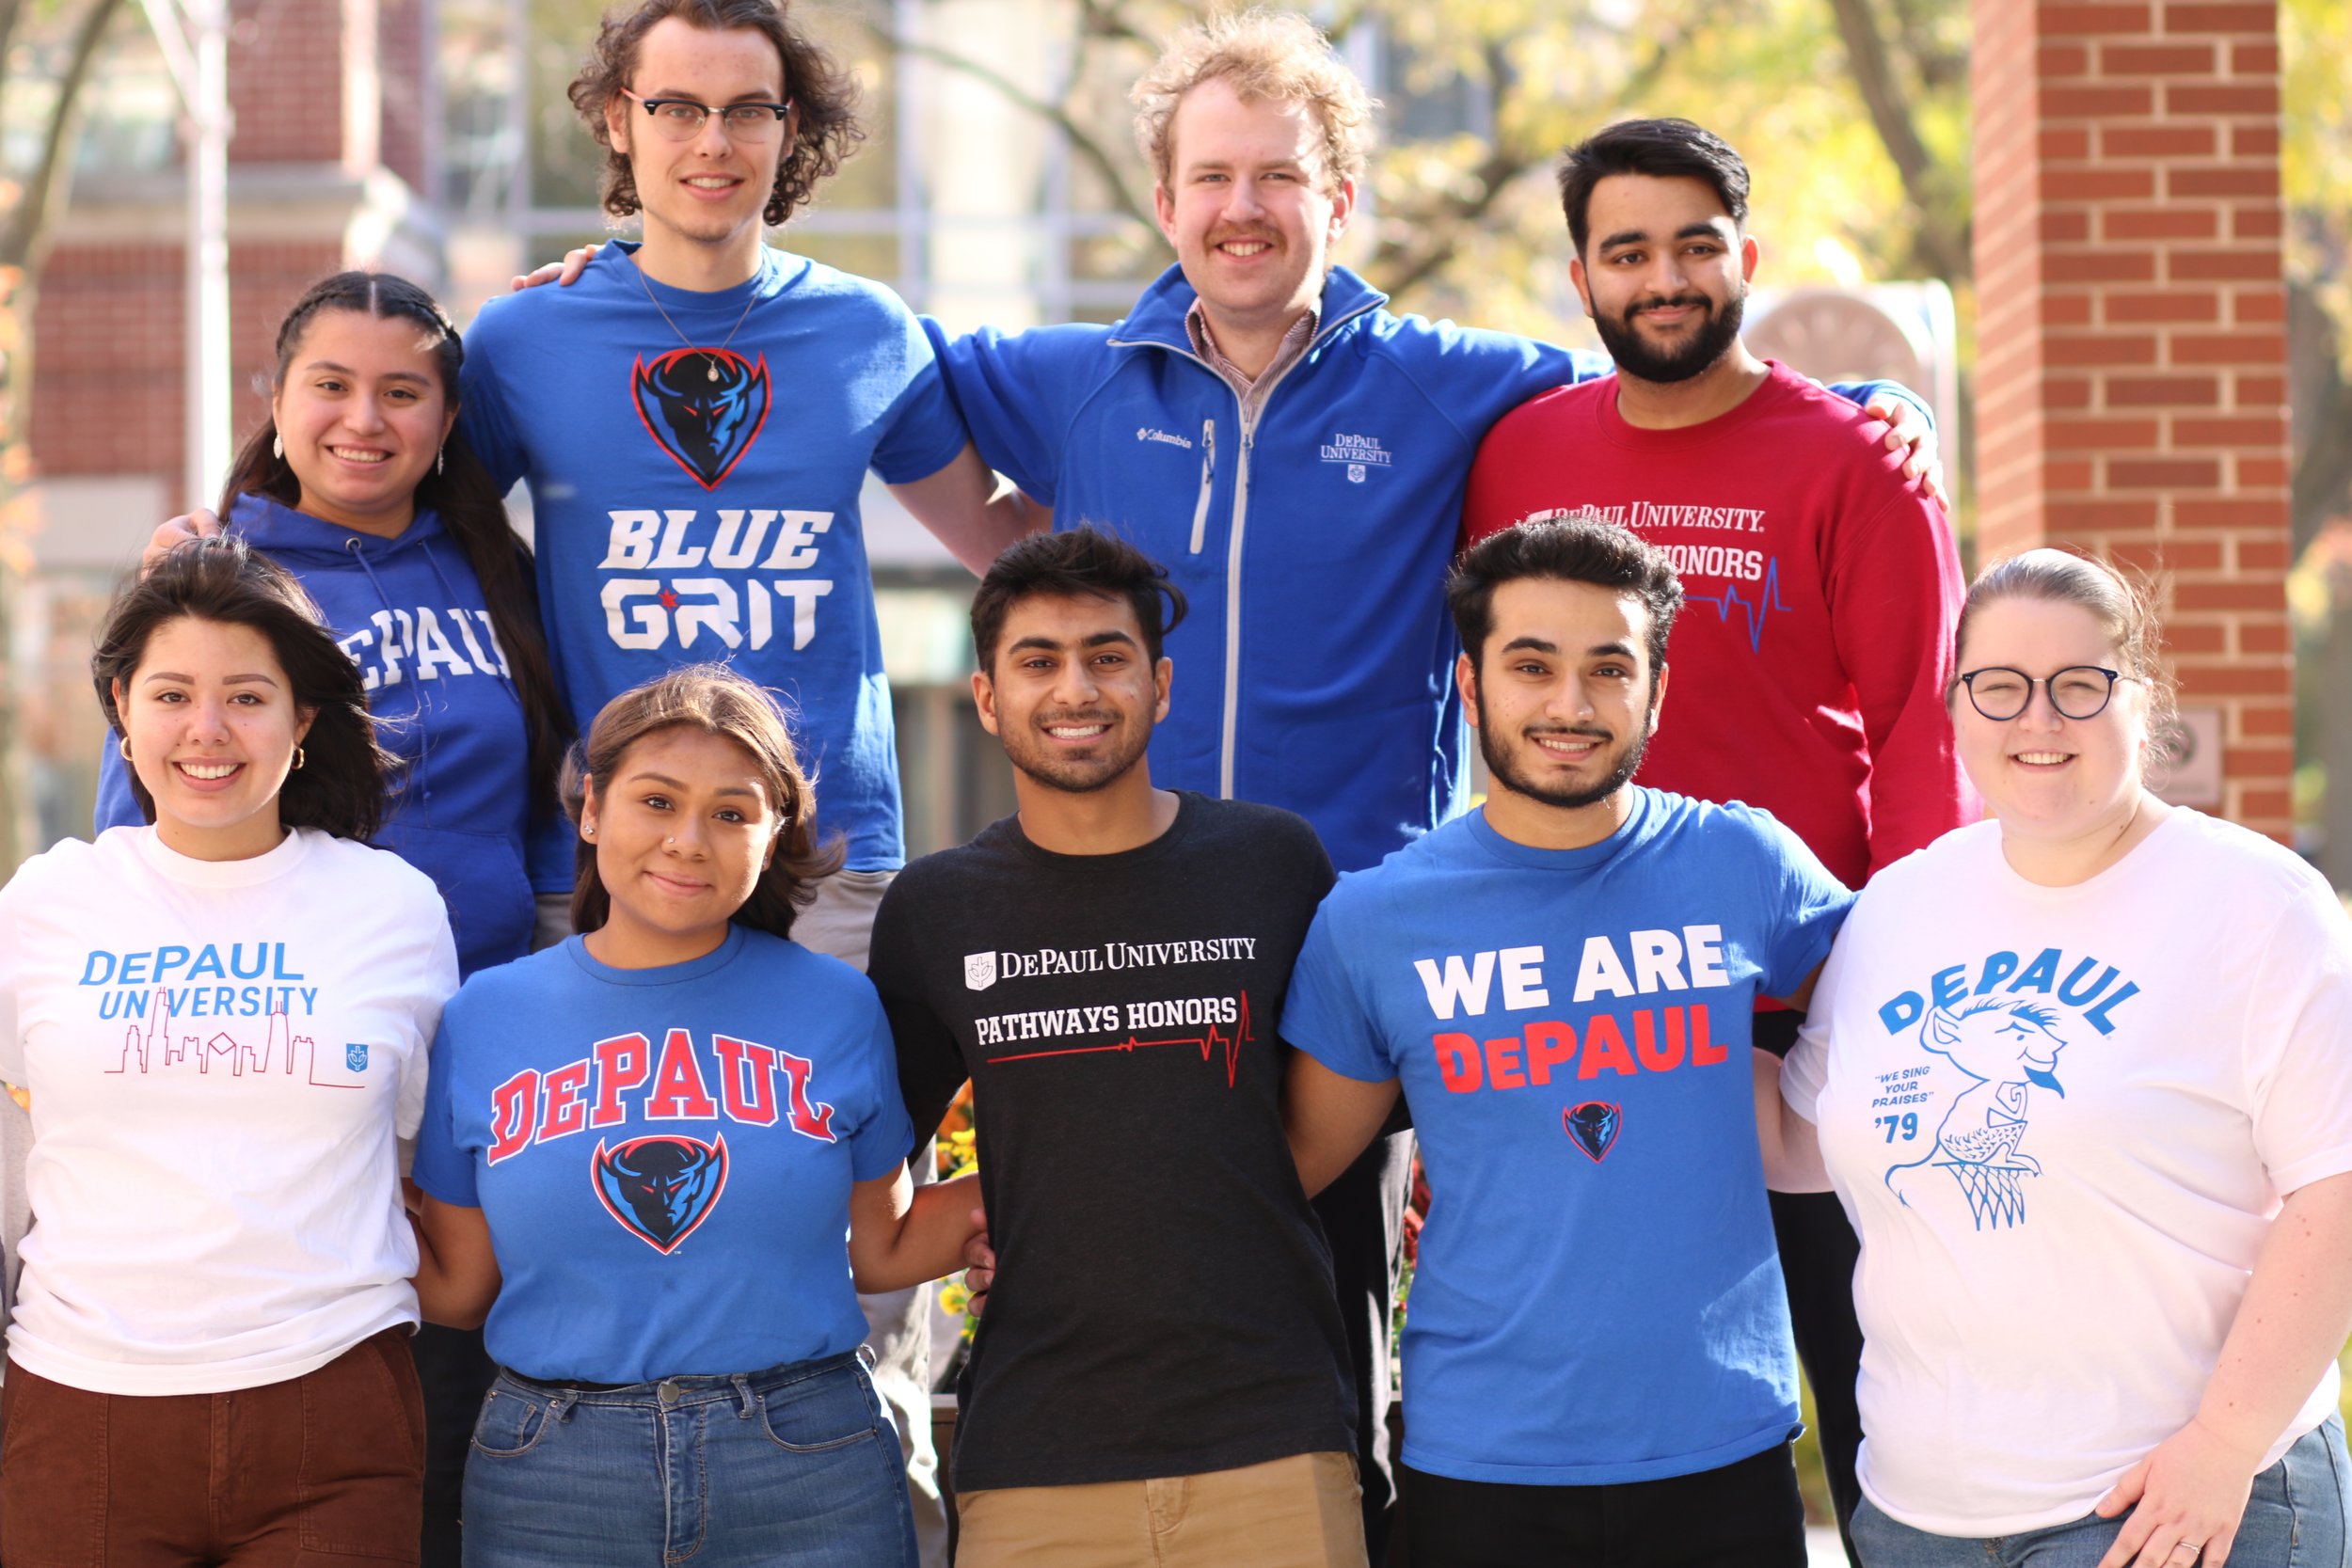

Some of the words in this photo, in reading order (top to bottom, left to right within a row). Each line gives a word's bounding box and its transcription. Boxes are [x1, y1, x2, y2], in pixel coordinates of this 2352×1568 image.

[1147, 428, 1192, 450] Columbia
[1320, 444, 1392, 464] UNIVERSITY
[596, 509, 834, 571] BLUE
[598, 578, 834, 651] GRIT
[335, 606, 512, 691] EPAU
[1104, 937, 1257, 971] UNIVERSITY
[1413, 944, 1550, 1021] WE
[1572, 924, 1731, 1004] ARE
[1877, 947, 2141, 1037] DEPAUL
[974, 1005, 1120, 1046] PATHWAYS
[1125, 996, 1238, 1030] HONORS
[1884, 1081, 1919, 1095] YOUR
[1901, 1066, 1931, 1080] SING
